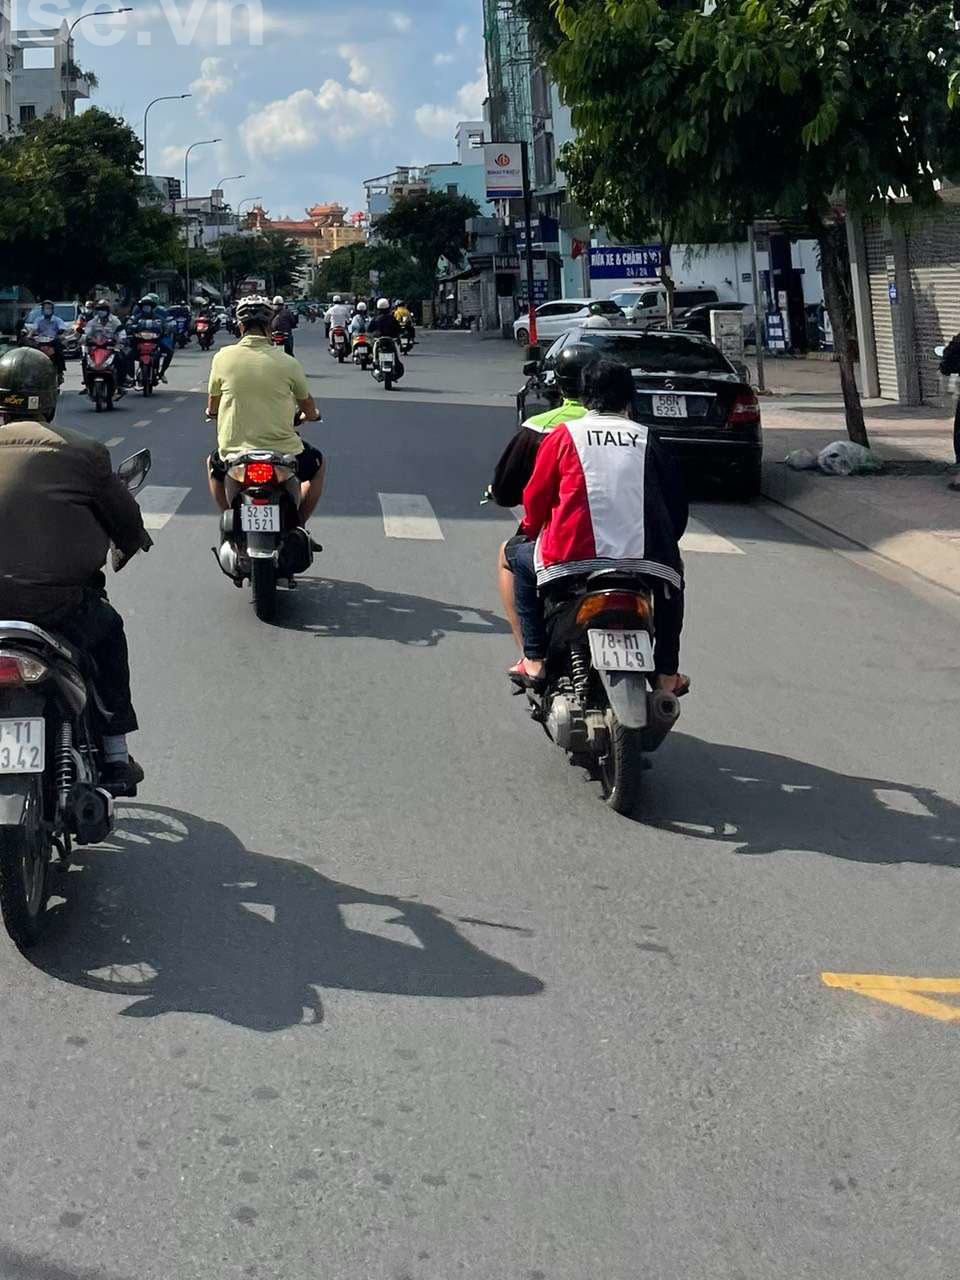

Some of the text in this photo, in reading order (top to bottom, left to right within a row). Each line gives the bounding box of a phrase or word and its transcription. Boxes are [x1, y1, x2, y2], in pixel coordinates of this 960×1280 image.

[587, 429, 639, 448] ITALY
[247, 518, 273, 530] 1521
[601, 651, 645, 668] 4149
